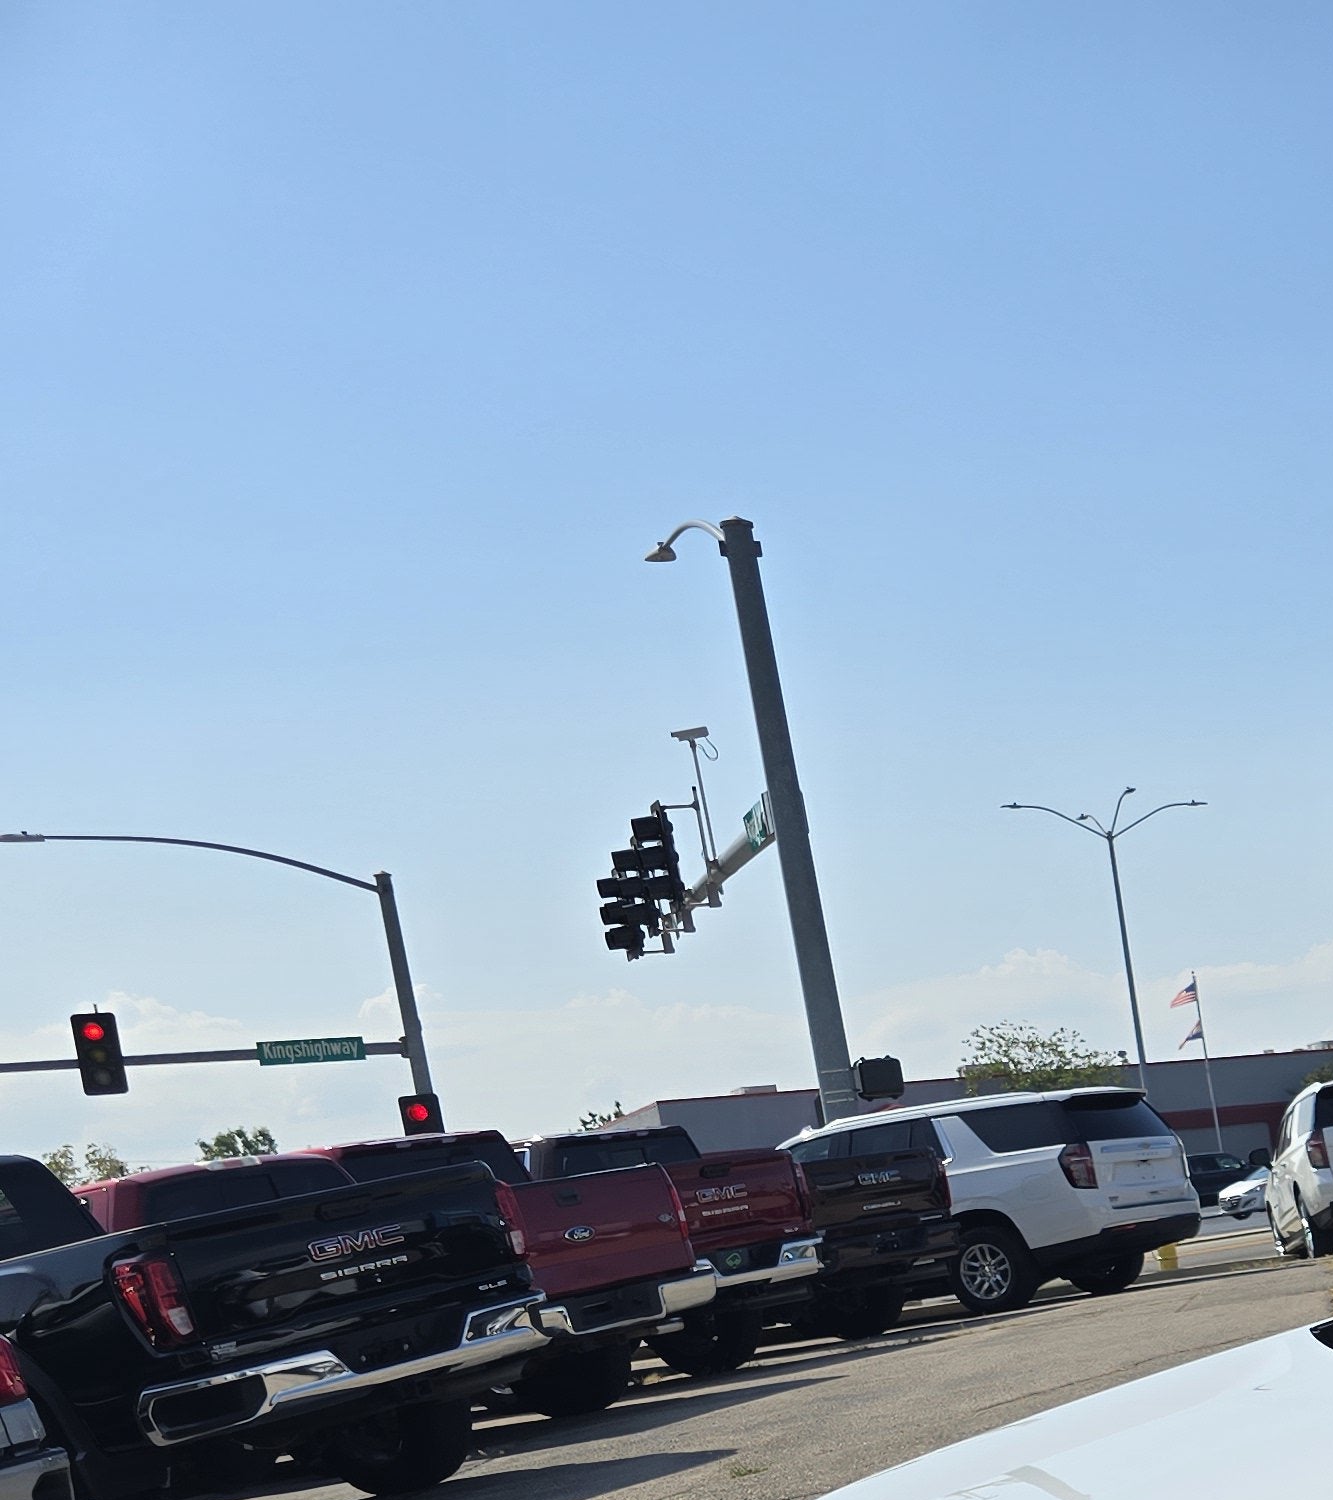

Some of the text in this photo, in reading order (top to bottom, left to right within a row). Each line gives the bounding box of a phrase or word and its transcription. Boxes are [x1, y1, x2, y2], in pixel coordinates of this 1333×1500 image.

[263, 1041, 358, 1062] Kingshighway
[696, 1184, 748, 1203] GMC
[308, 1224, 404, 1261] GMC
[320, 1255, 407, 1281] SIERRA
